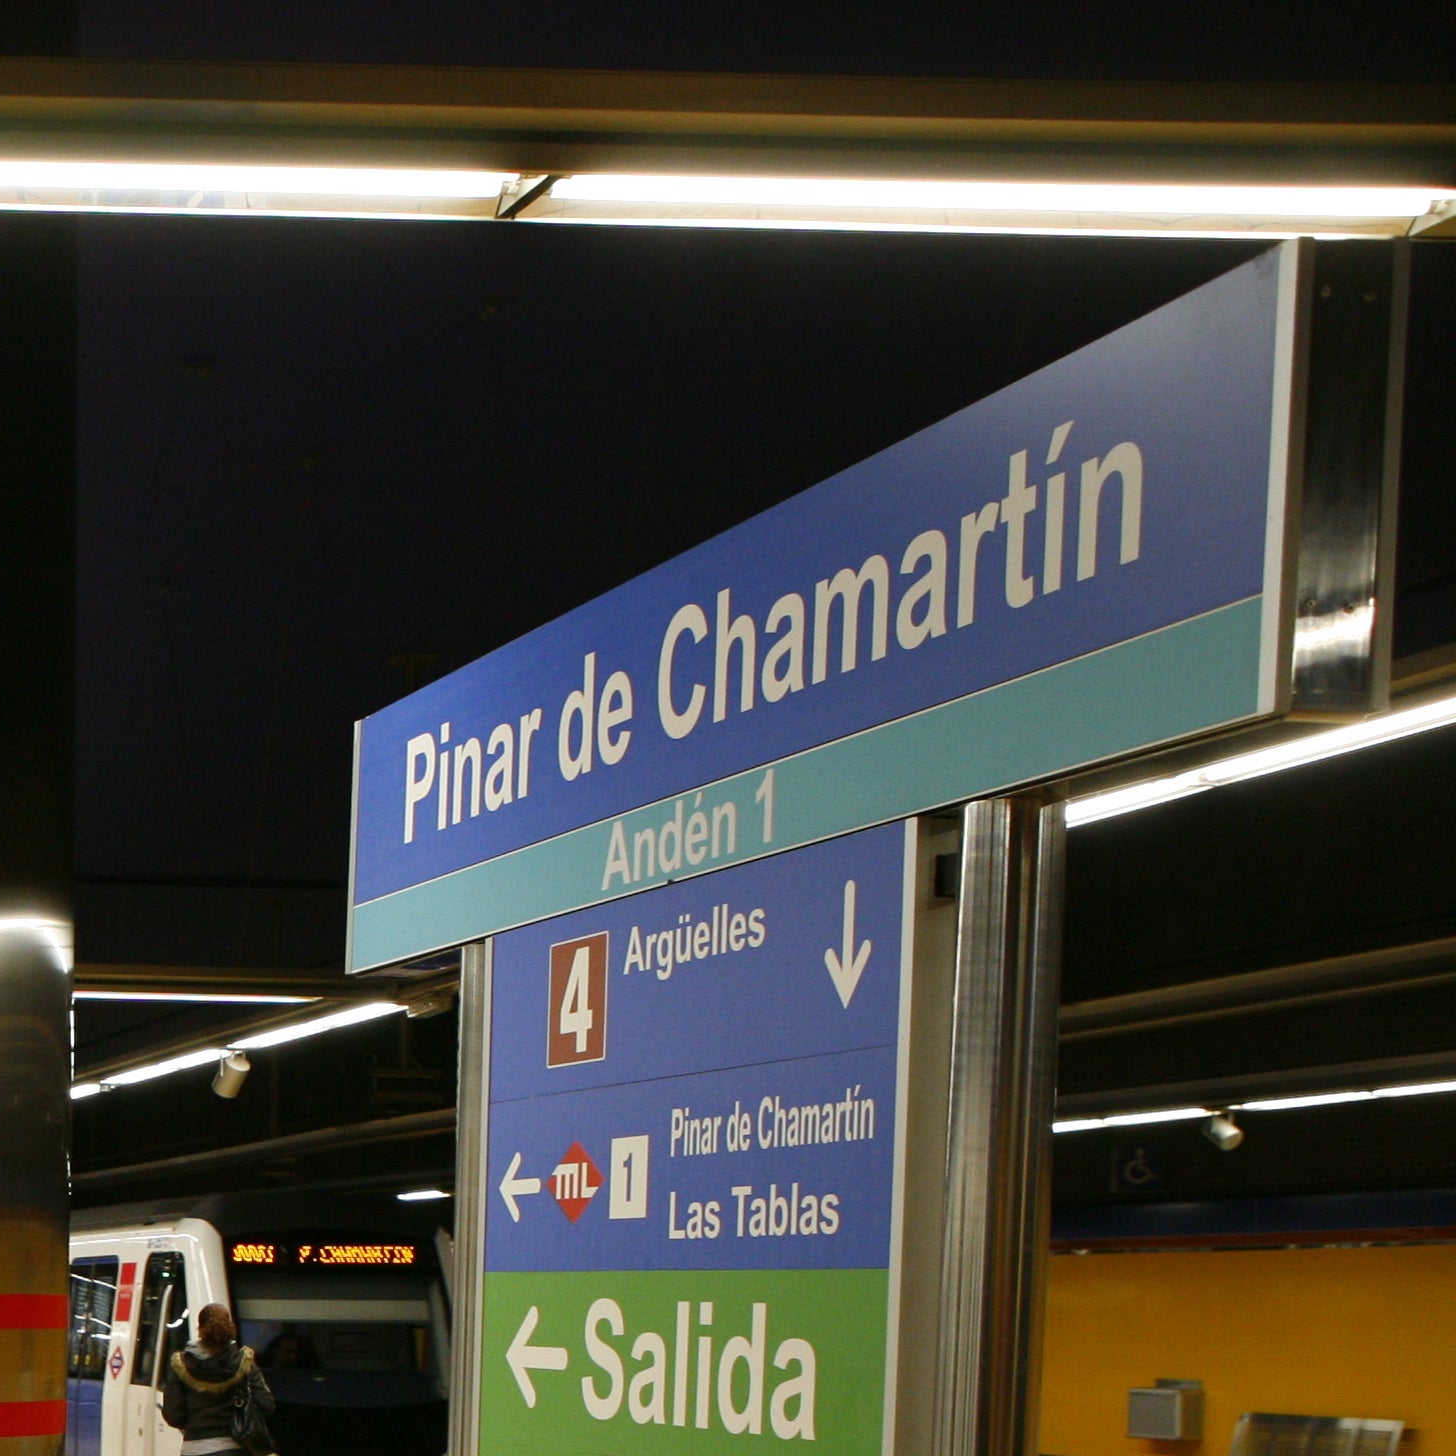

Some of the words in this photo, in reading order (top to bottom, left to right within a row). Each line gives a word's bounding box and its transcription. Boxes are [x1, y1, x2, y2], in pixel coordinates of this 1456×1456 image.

[403, 721, 542, 844] Pinar
[559, 651, 632, 782] de
[658, 420, 1143, 740] Chamartín
[600, 790, 738, 892] Andén
[755, 768, 775, 843] 1
[622, 903, 767, 981] Argüelles
[559, 946, 593, 1053] 4
[670, 1105, 723, 1158] Pinar
[726, 1100, 752, 1153] de
[757, 1085, 875, 1150] Chamartín
[623, 1152, 633, 1202] 1
[668, 1191, 721, 1240] Las
[731, 1182, 840, 1238] Tablas
[580, 1297, 817, 1441] Salida
